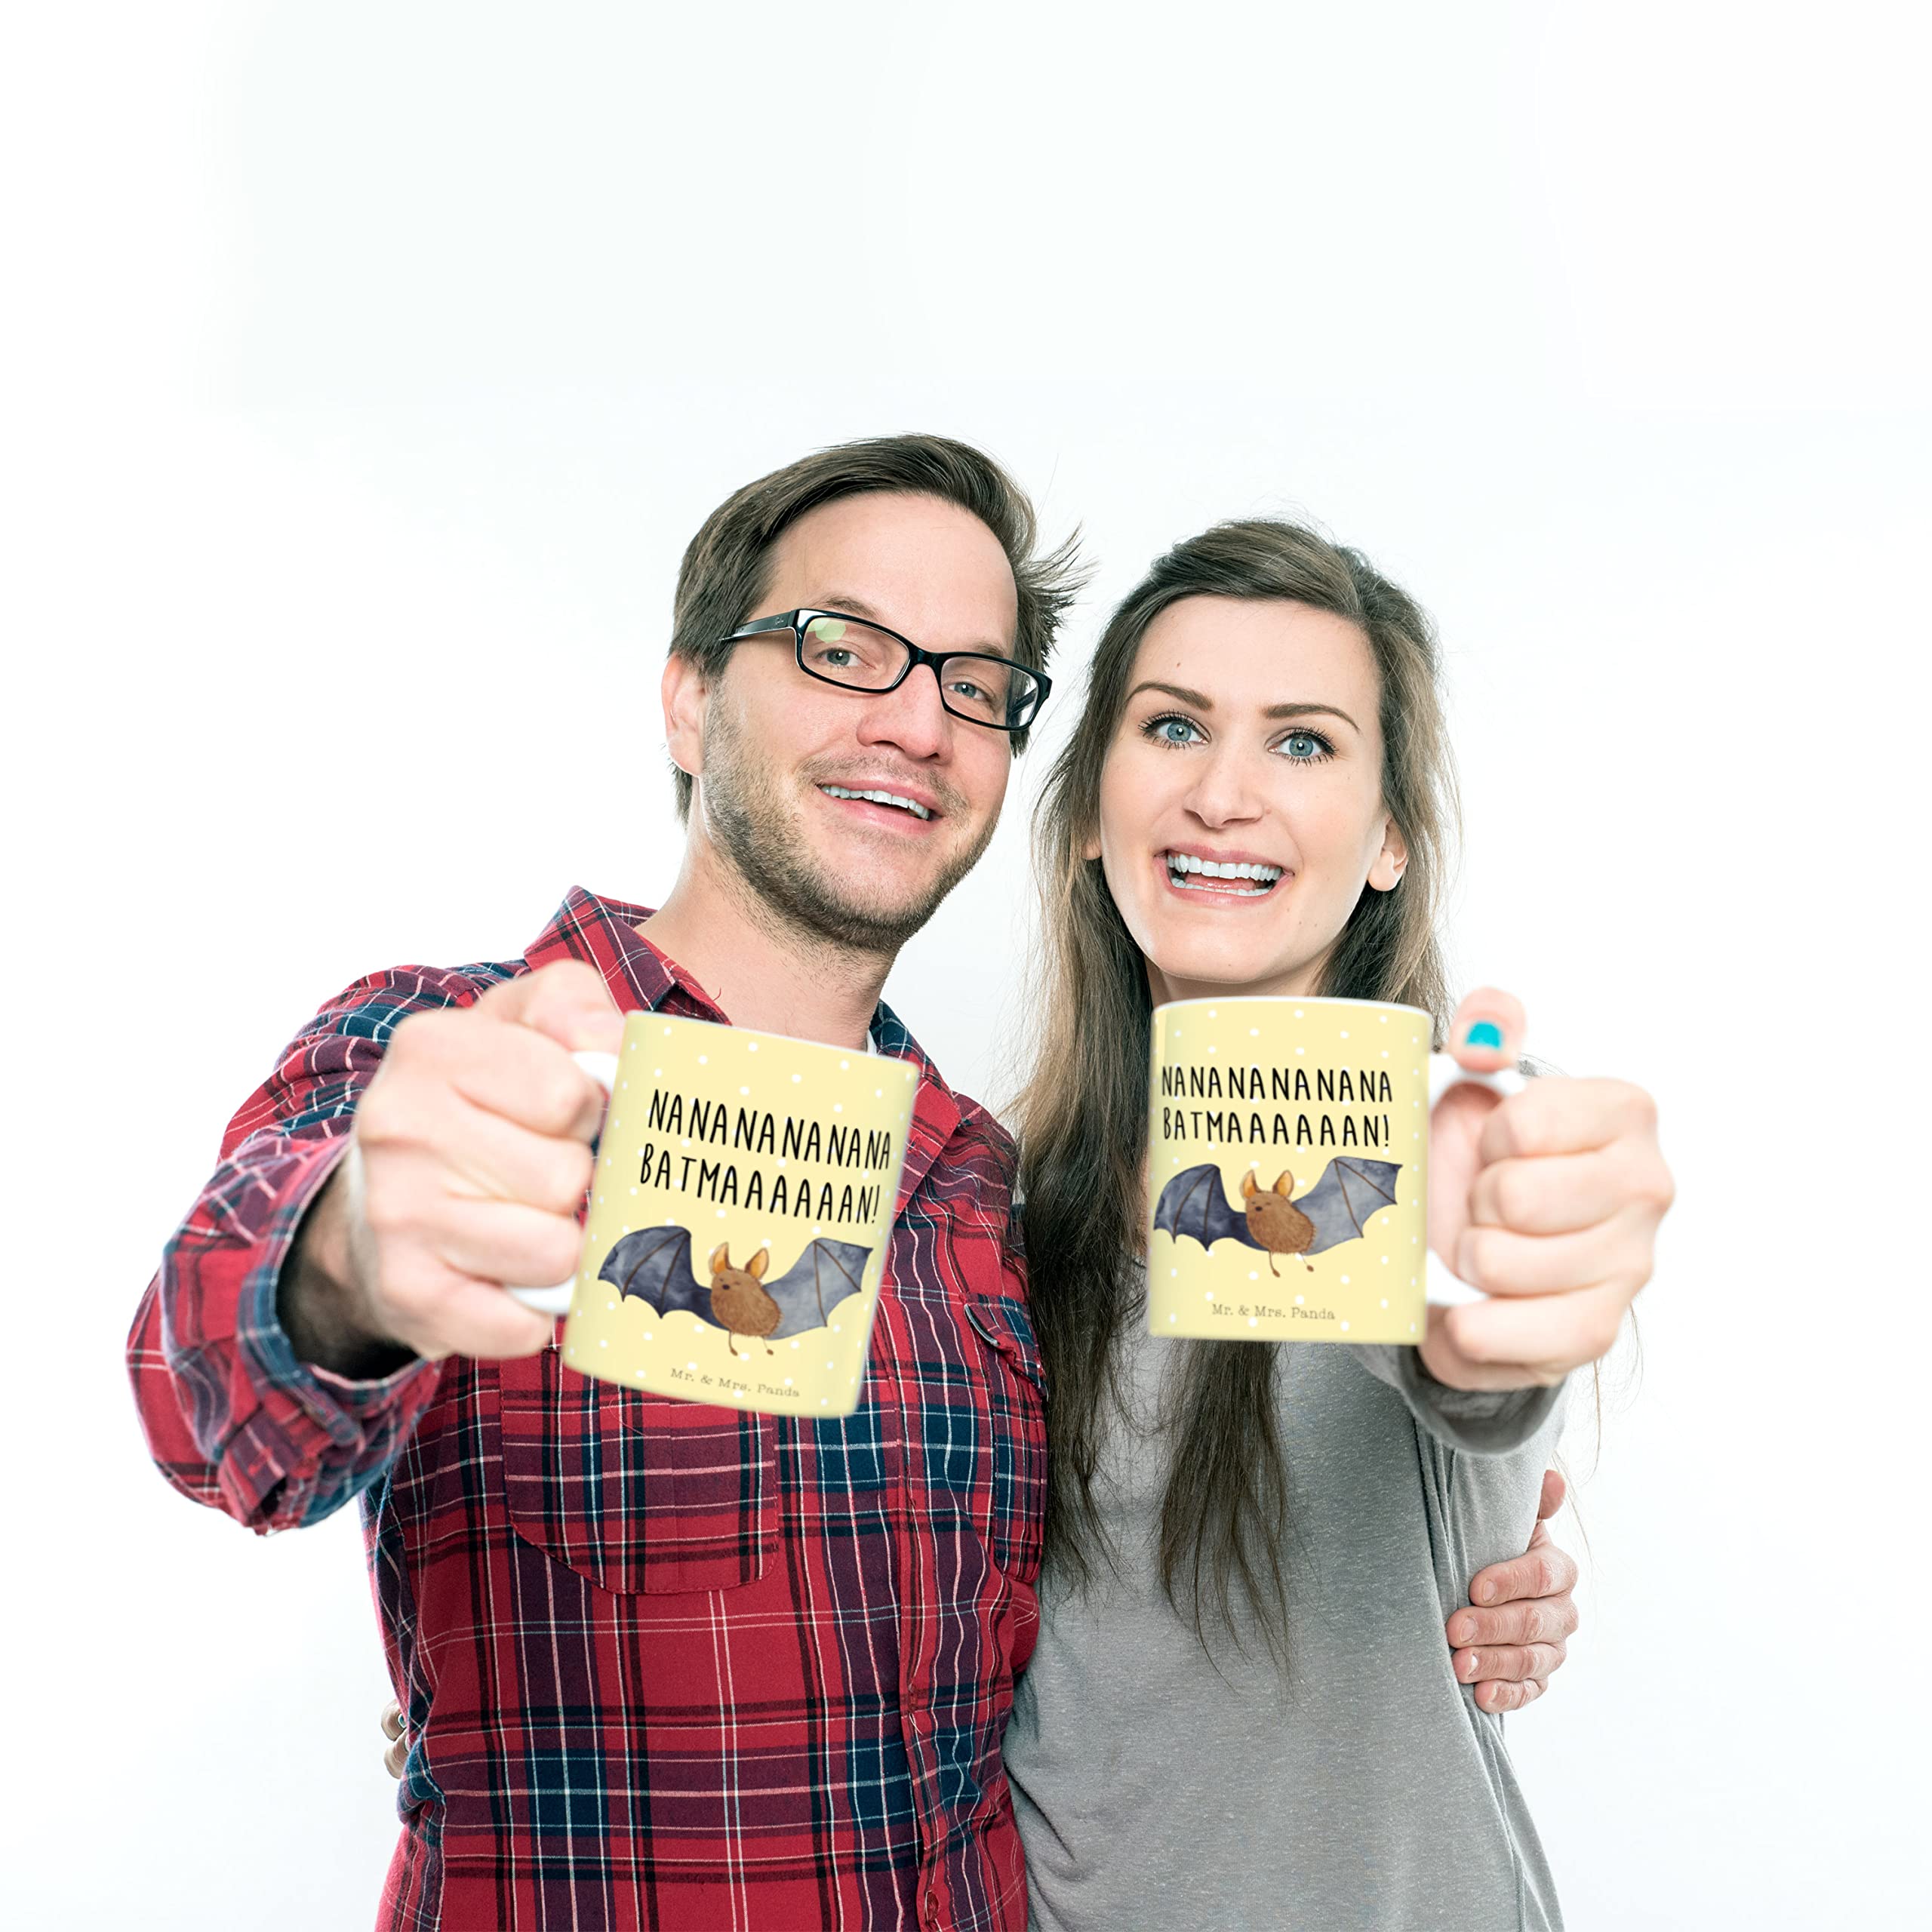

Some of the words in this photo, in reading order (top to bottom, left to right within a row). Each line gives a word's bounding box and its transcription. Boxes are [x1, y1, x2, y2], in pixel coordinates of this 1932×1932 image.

[1161, 1066, 1392, 1103] NANANANANANA
[648, 1089, 891, 1171] NANANANANANA
[1163, 1107, 1389, 1148] BATMAAAAAAN!
[640, 1143, 881, 1225] BATMAAAAAAN!
[1212, 1303, 1234, 1316] Mr.
[1238, 1306, 1251, 1316] &
[1254, 1306, 1286, 1318] Mrs.
[1291, 1307, 1335, 1320] Panda
[670, 1367, 695, 1383] Mr.
[700, 1374, 713, 1386] &
[718, 1376, 752, 1393] Mrs.
[757, 1383, 800, 1398] Panda
